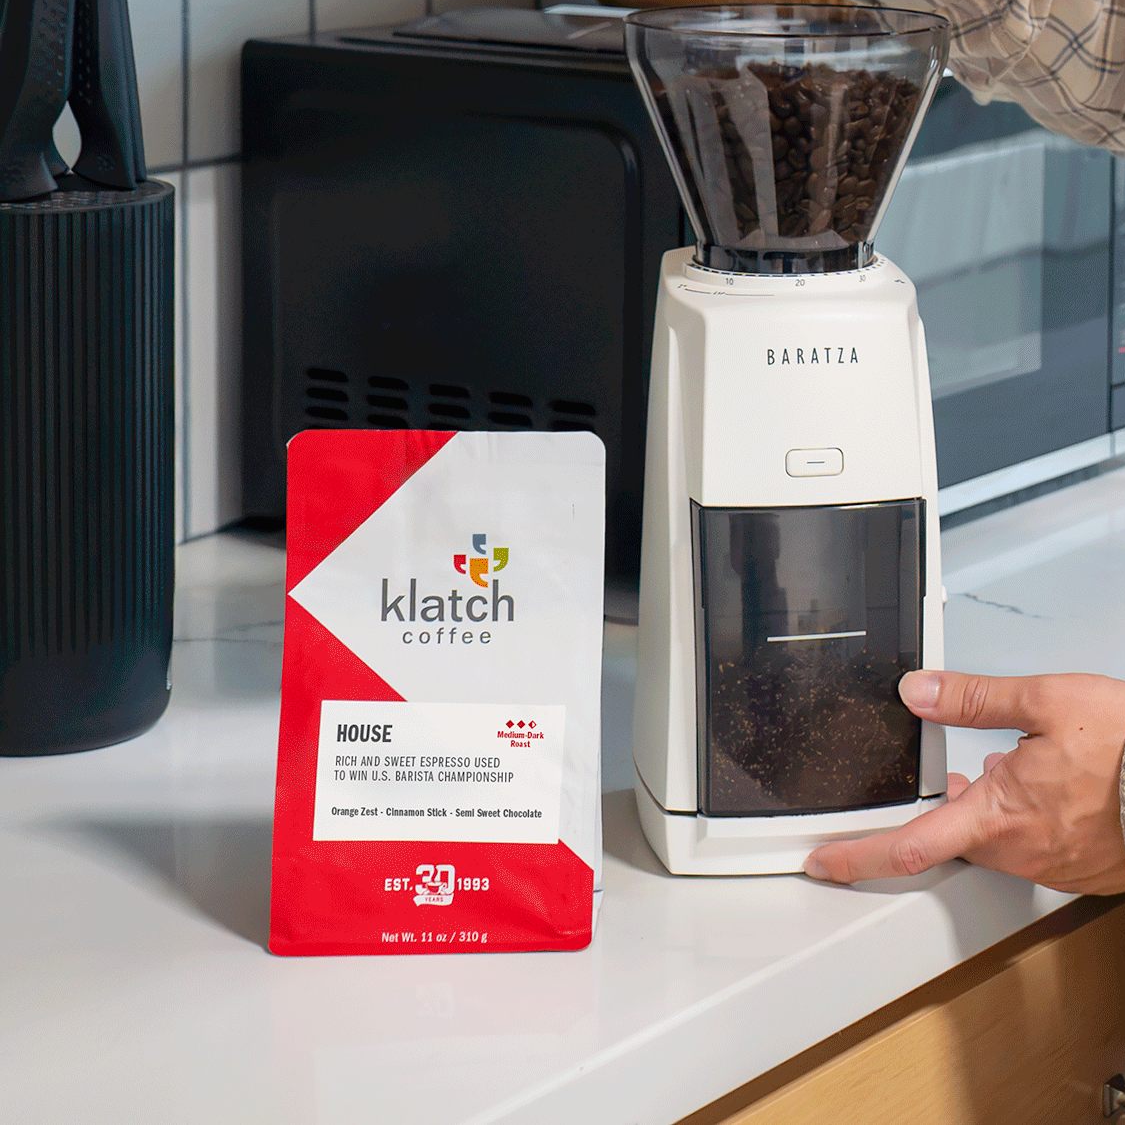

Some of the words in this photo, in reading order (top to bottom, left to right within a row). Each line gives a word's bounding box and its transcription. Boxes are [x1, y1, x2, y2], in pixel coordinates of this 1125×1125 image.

[725, 278, 734, 286] 10
[795, 278, 805, 287] 20
[859, 274, 867, 283] 30
[767, 347, 859, 366] BARATZA
[381, 578, 515, 622] klatch
[402, 627, 492, 644] coffee
[336, 724, 393, 743] HOUSE
[497, 730, 544, 739] Medium-Dark
[510, 739, 531, 748] Roast
[335, 755, 357, 767] RICH
[360, 756, 381, 767] AND
[384, 756, 416, 767] SWEET
[420, 756, 471, 768] ESPRESSO
[474, 757, 501, 768] USED
[334, 770, 346, 781] TO
[349, 770, 368, 781] WIN
[371, 770, 391, 781] U.S.
[395, 771, 434, 782] BARISTA
[438, 771, 514, 783] CHAMPIONSHIP
[331, 806, 359, 817] Orange
[360, 807, 378, 816] Zest
[386, 807, 425, 816] Cinnamon
[427, 807, 447, 817] Stick
[455, 808, 475, 817] Semi
[477, 808, 501, 817] Sweet
[503, 809, 542, 818] Chocolate
[384, 878, 413, 891] EST.
[415, 864, 456, 895] 30
[457, 877, 489, 891] 1993
[381, 932, 399, 943] Net
[401, 932, 417, 943] Wt.
[421, 931, 433, 942] 11
[436, 933, 447, 943] oz
[459, 931, 479, 942] 310
[481, 932, 488, 944] g
